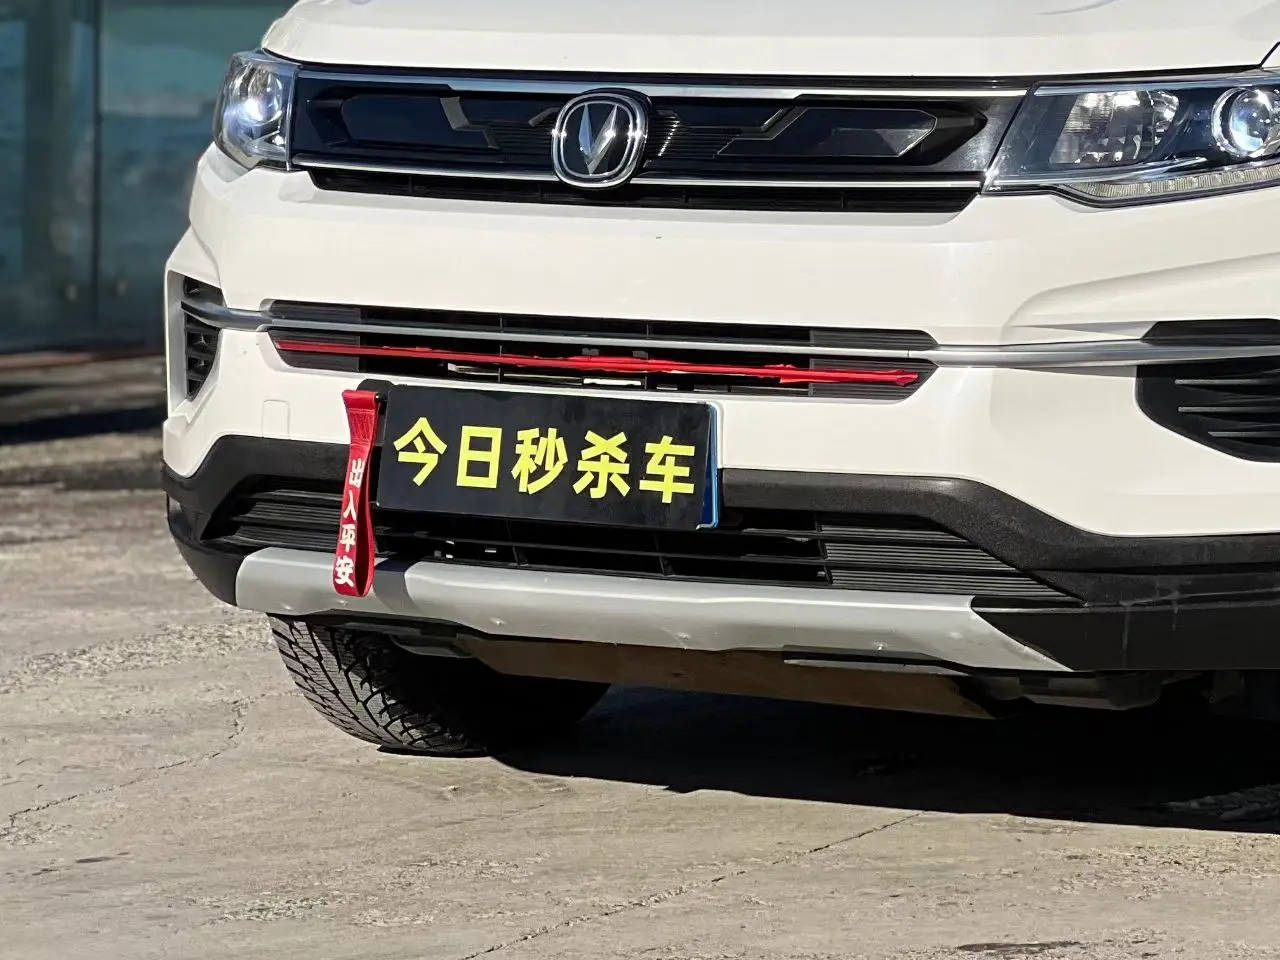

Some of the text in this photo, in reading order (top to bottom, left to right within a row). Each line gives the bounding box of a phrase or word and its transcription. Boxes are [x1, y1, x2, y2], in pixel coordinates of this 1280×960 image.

[393, 416, 696, 504] 今日秒杀车
[334, 457, 366, 588] 出入平安
